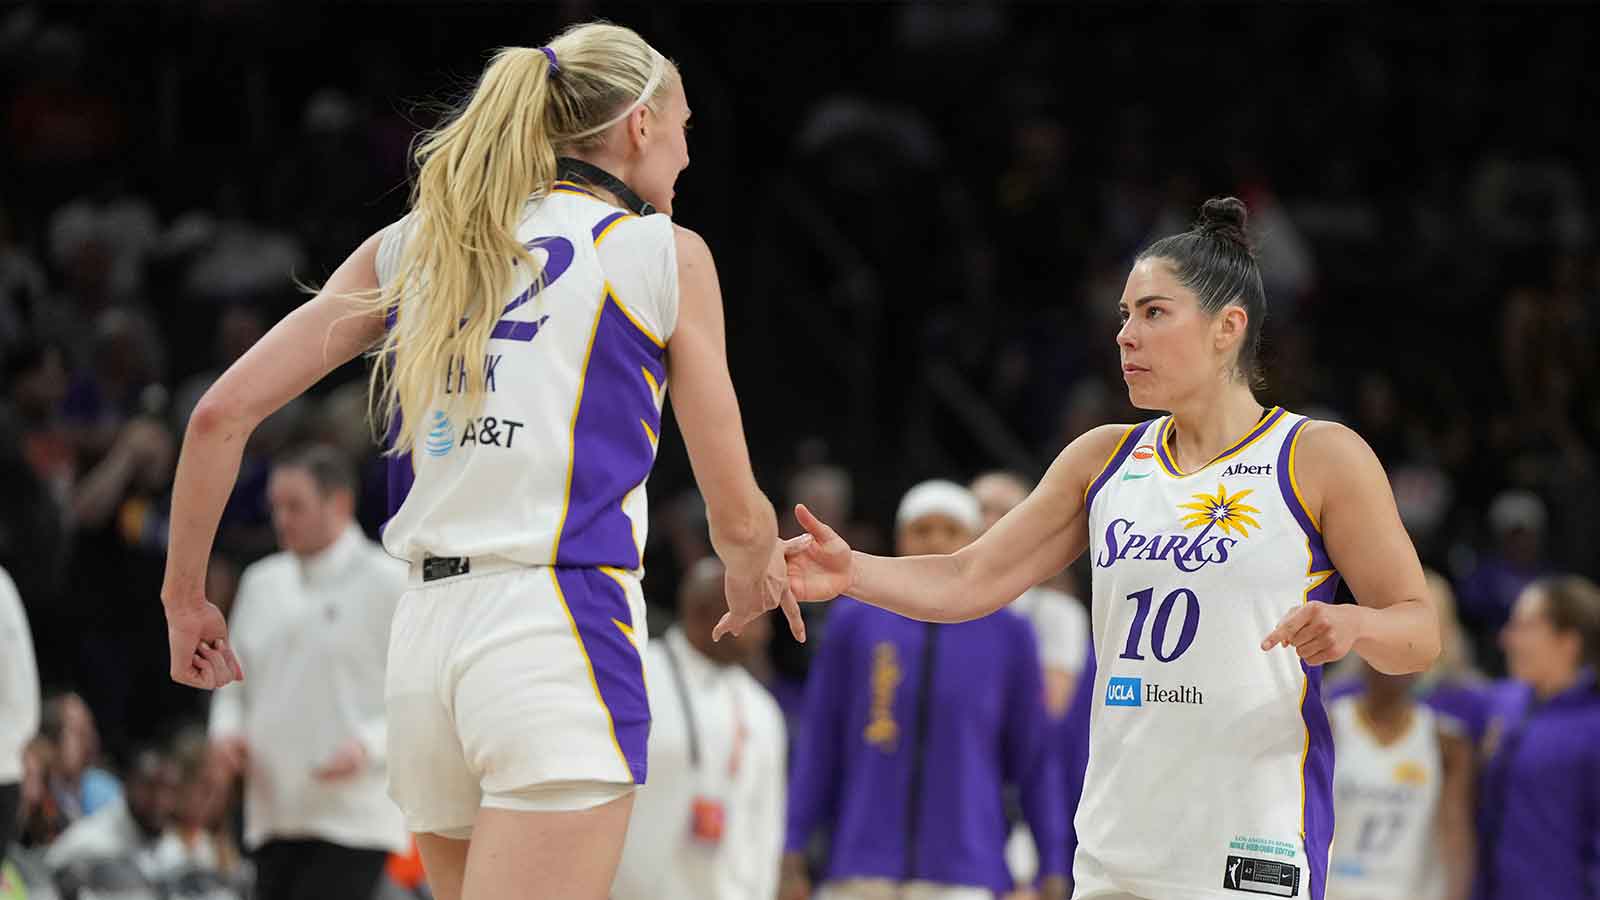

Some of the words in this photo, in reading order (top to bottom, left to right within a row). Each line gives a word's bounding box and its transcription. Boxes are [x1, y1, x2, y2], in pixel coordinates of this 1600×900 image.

[1221, 463, 1273, 477] Albert
[1119, 586, 1201, 663] 10
[1107, 684, 1135, 701] UCLA
[1146, 684, 1204, 705] Health
